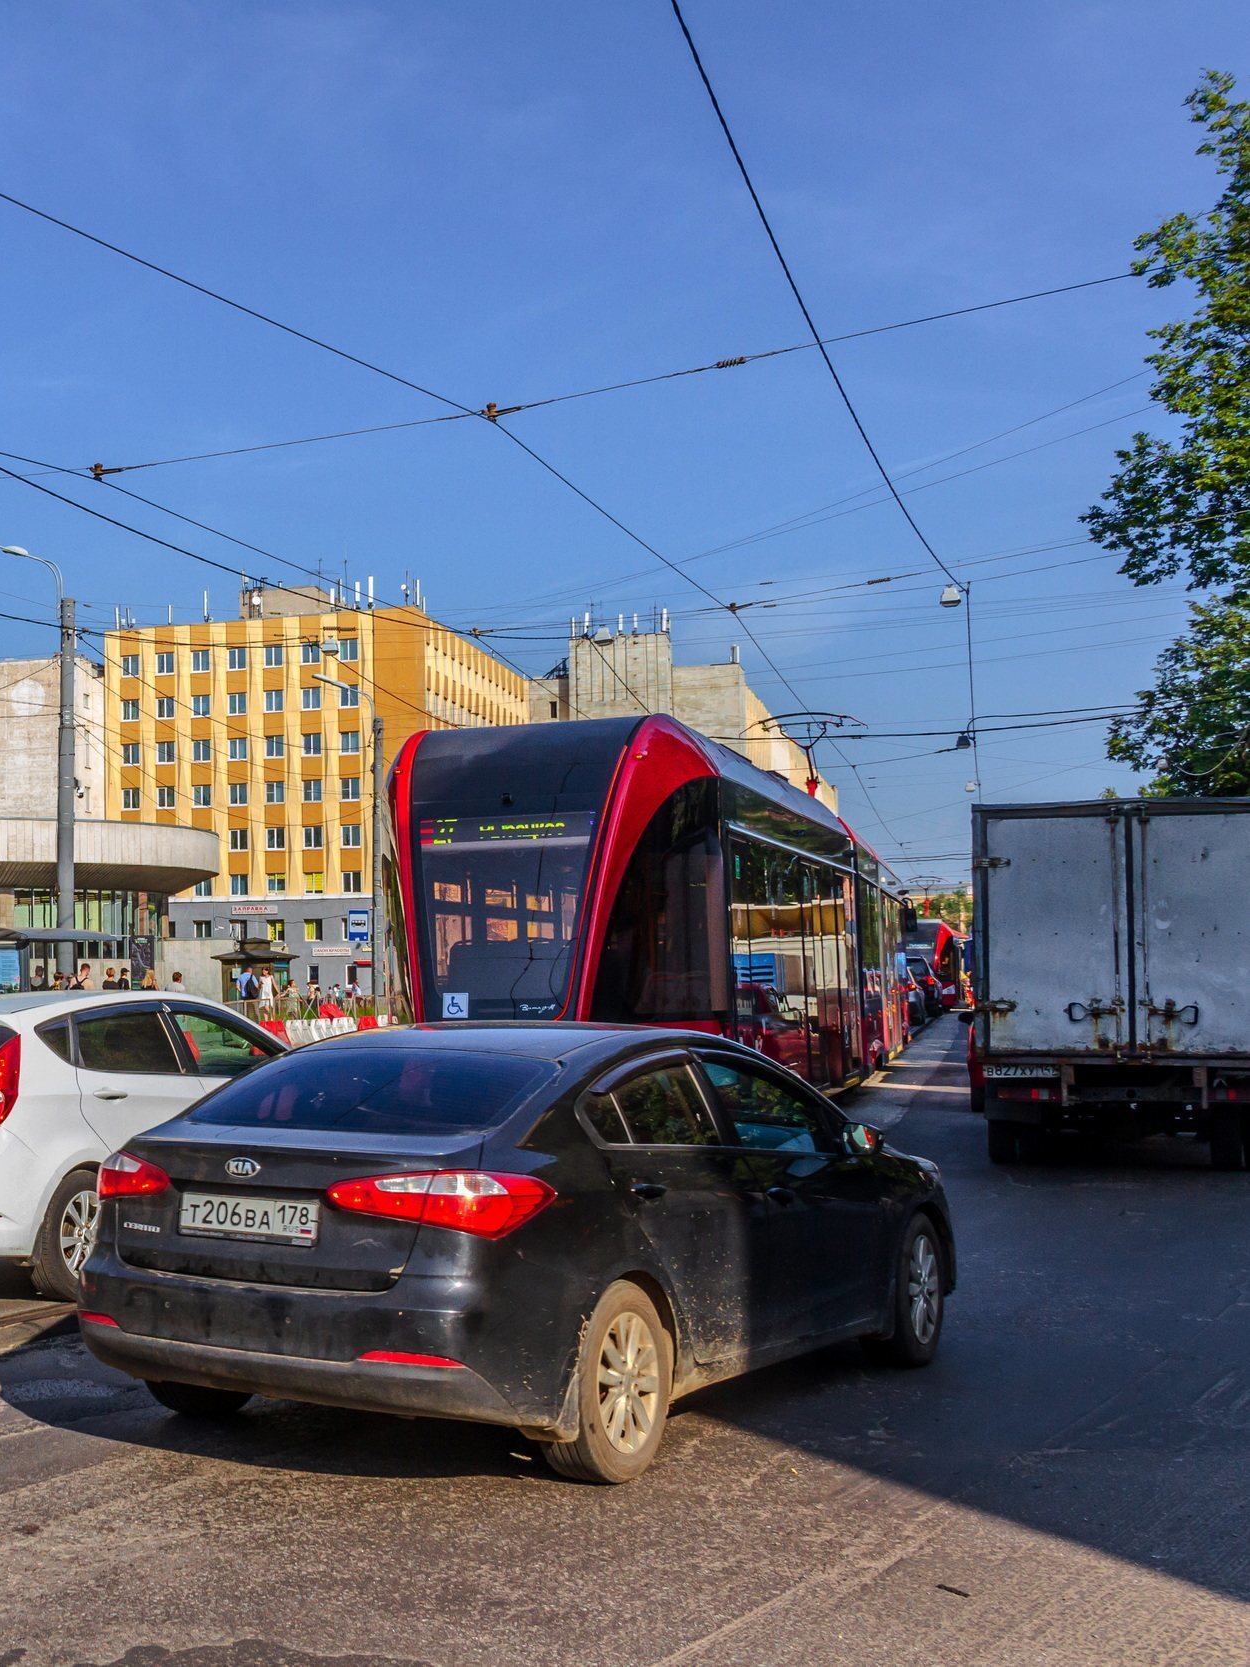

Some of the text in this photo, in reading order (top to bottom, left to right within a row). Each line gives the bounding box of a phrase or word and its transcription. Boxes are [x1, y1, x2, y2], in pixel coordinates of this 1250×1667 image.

[228, 1160, 253, 1175] KIA
[277, 1204, 310, 1226] 178
[282, 1225, 300, 1233] RUS
